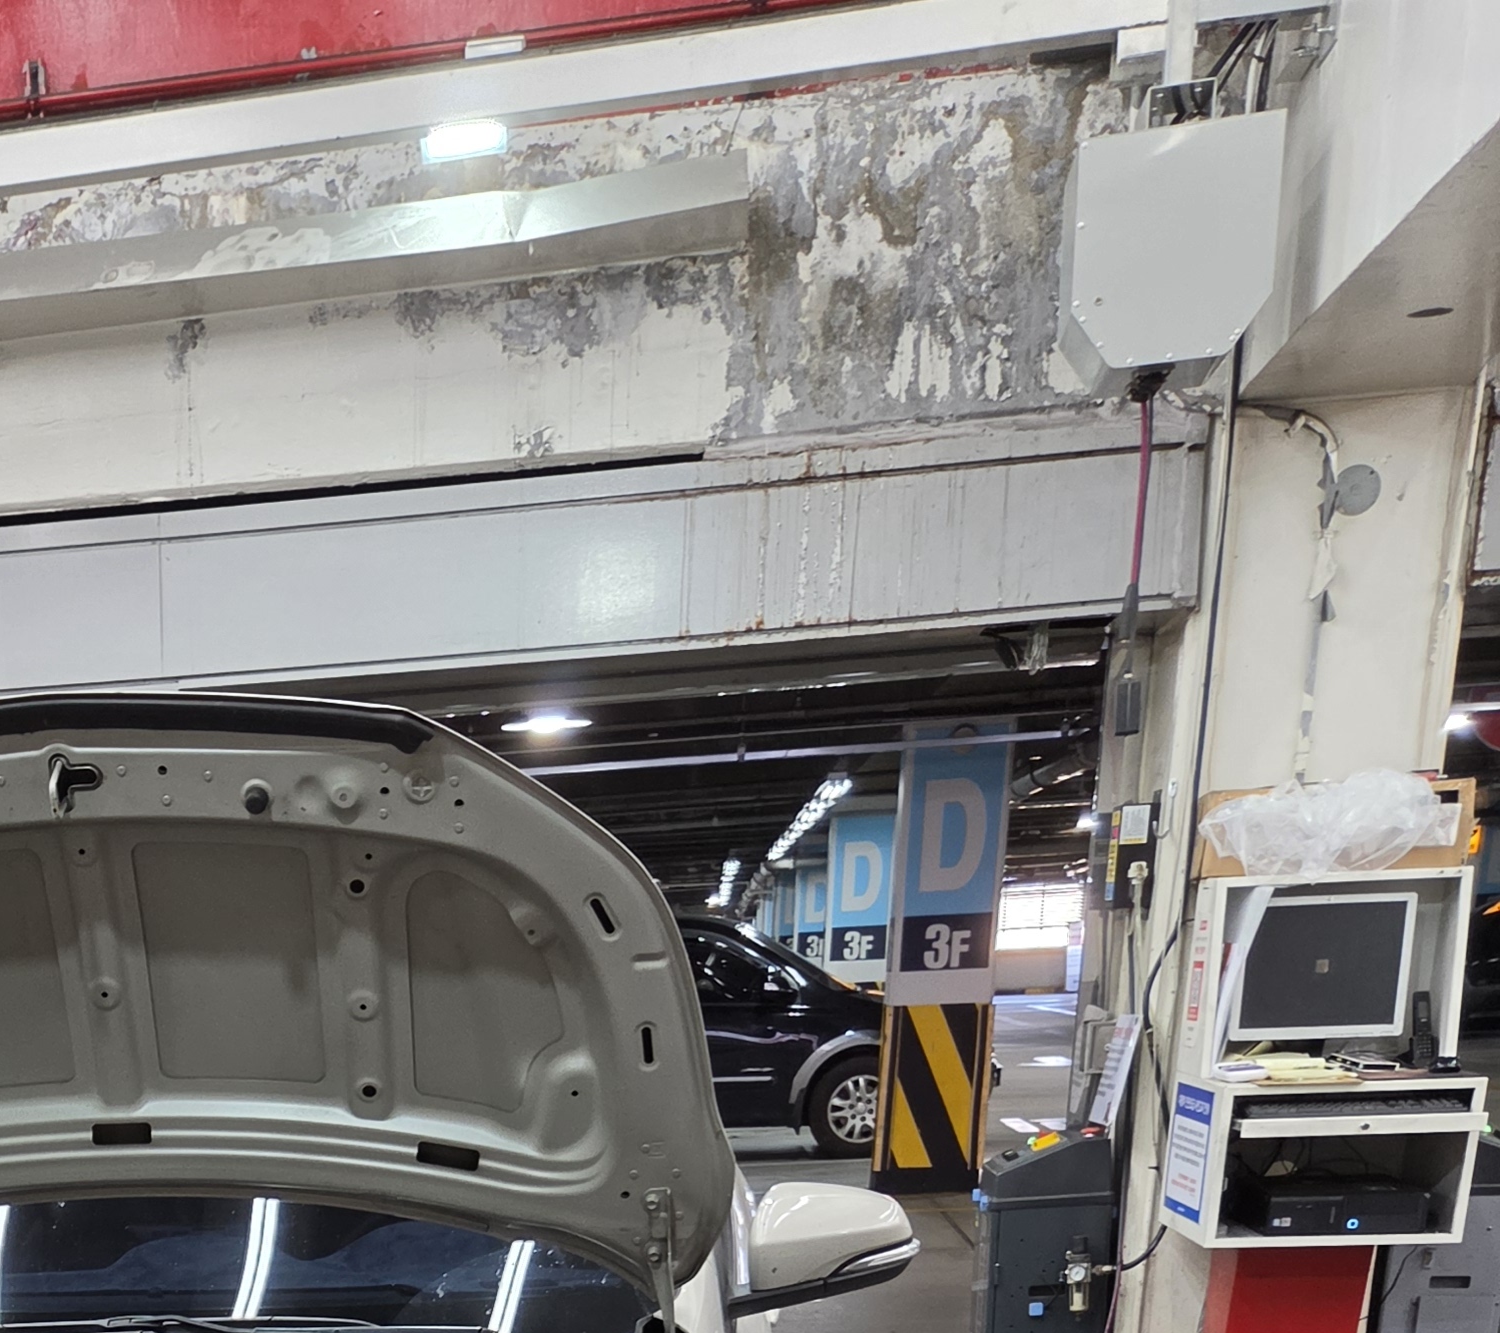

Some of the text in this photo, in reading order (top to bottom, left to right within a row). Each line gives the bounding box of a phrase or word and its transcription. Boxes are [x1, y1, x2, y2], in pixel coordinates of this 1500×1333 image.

[919, 777, 987, 892] D
[840, 840, 883, 912] D
[842, 930, 875, 961] 3F
[923, 923, 972, 969] 3F
